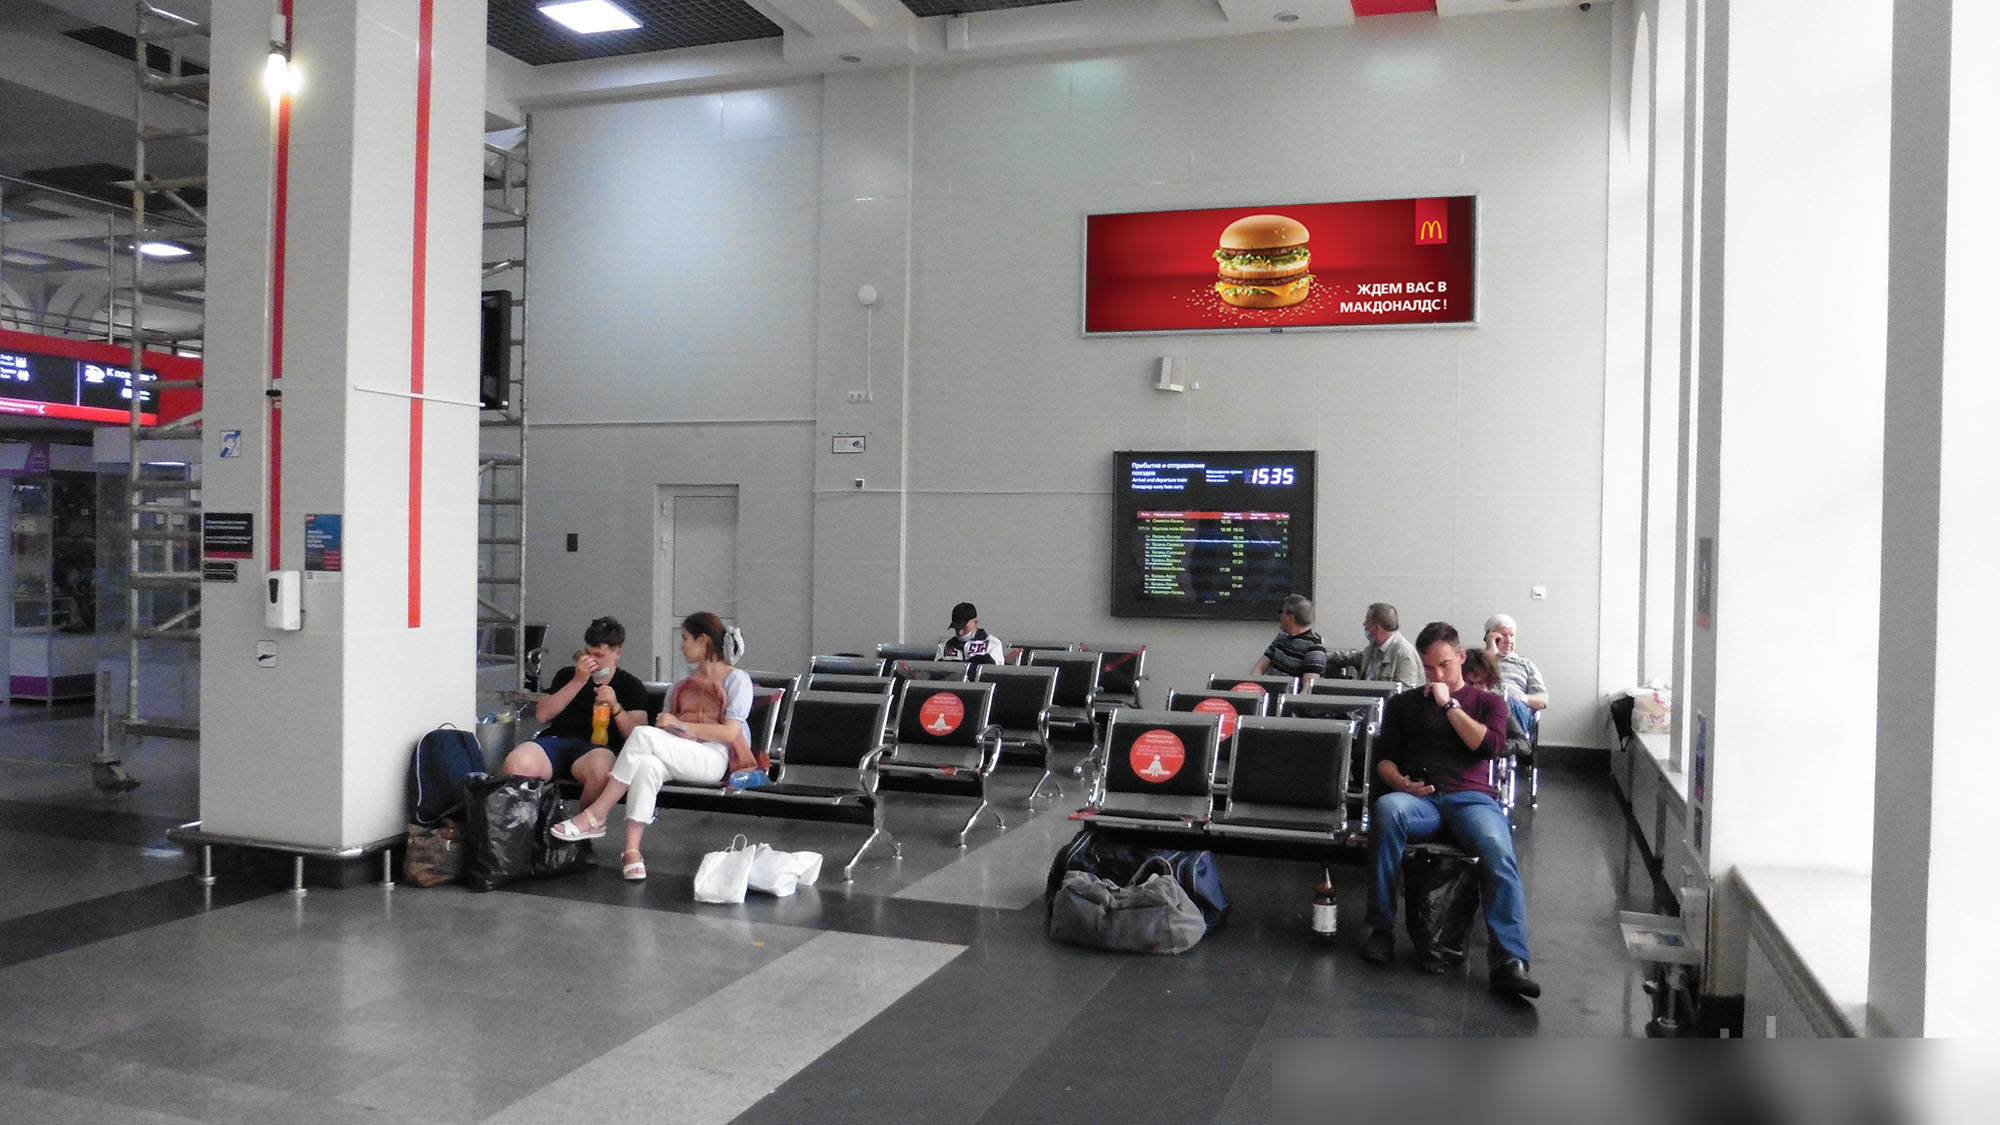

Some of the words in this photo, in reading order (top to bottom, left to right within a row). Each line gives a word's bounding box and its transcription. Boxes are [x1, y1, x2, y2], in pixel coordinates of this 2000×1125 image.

[1357, 283, 1403, 297] ЖДЕМ
[1406, 281, 1435, 294] ВАС
[1437, 281, 1447, 293] В
[1131, 462, 1161, 470] Прибытие
